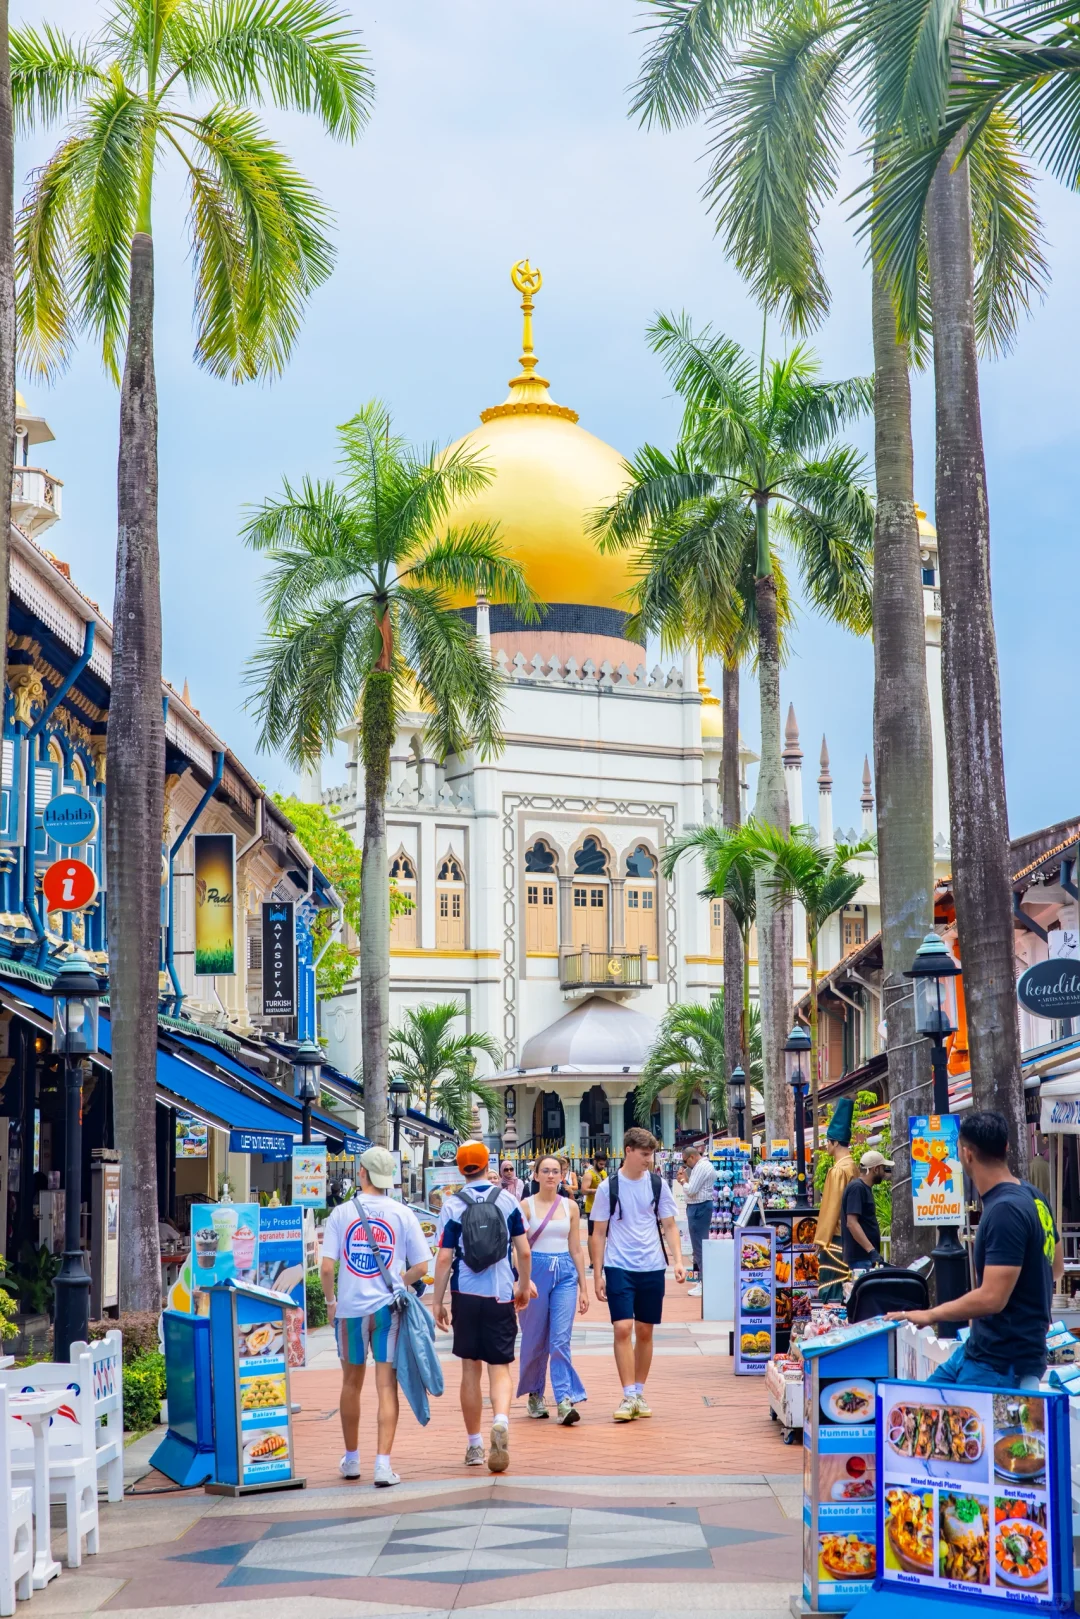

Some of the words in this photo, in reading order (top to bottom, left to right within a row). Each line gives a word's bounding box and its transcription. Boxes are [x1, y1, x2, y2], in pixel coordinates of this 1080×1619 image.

[46, 808, 92, 821] Habibi
[274, 923, 282, 998] AYASOFYA
[930, 1193, 945, 1204] NO
[917, 1203, 961, 1216] TOUTING!
[273, 1217, 301, 1226] Pressed
[286, 1231, 301, 1239] Juice
[351, 1252, 385, 1270] SPEEDWY
[820, 1429, 860, 1437] Hummus
[247, 1464, 270, 1473] Salmon
[927, 1479, 943, 1487] Mandi
[944, 1481, 962, 1490] Platter
[1017, 1491, 1036, 1500] Kunefe
[897, 1573, 920, 1583] Musakka
[948, 1581, 957, 1589] Sac
[958, 1583, 982, 1593] Kavurma
